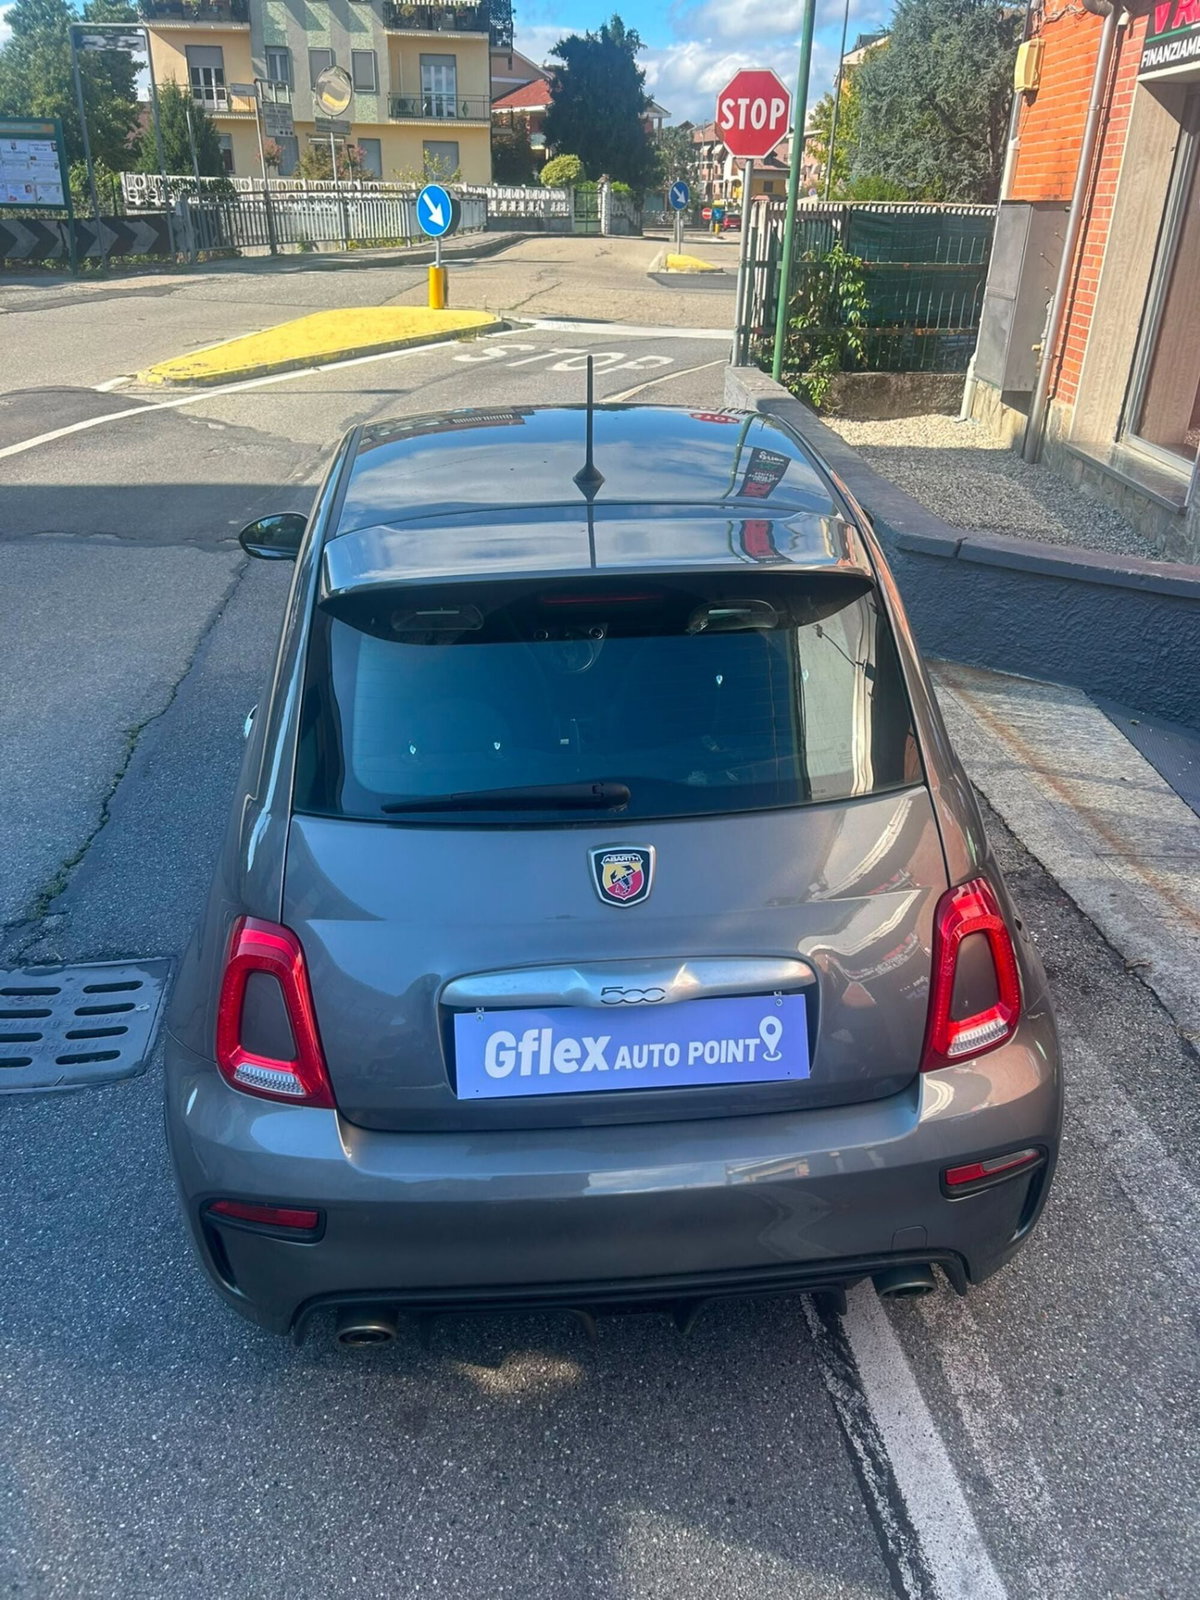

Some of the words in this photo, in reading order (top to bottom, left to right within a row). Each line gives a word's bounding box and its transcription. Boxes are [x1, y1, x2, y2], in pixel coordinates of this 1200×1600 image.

[720, 97, 786, 130] STOP
[452, 344, 675, 375] STOP
[600, 986, 666, 1005] 500
[484, 1027, 612, 1079] Gflex
[614, 1042, 681, 1070] AUTO
[688, 1037, 761, 1066] POINT
